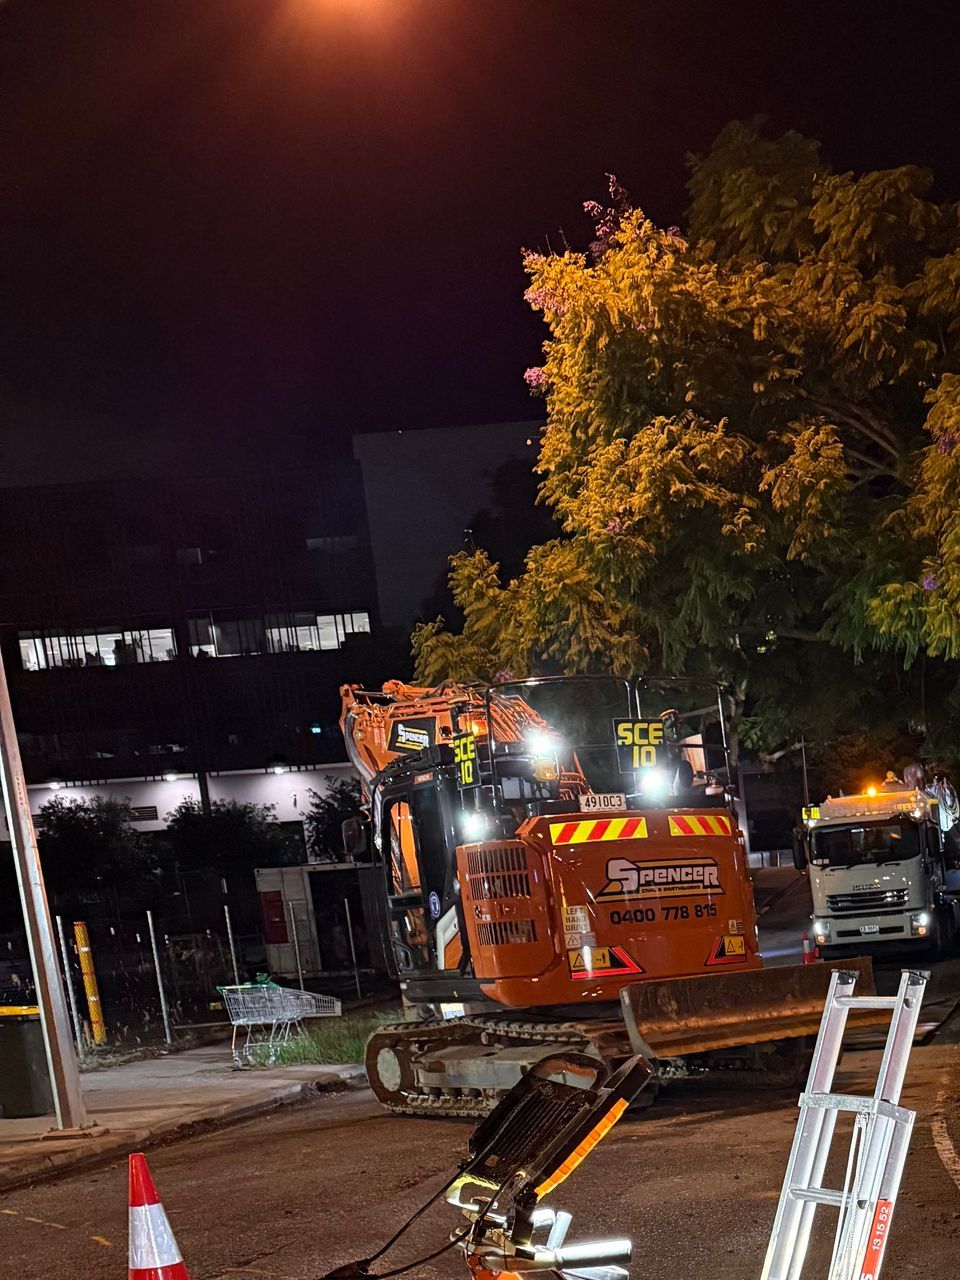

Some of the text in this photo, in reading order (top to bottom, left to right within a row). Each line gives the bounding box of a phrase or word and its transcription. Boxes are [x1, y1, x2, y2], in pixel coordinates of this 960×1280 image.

[617, 723, 664, 745] SCE
[454, 735, 475, 763] SCE
[632, 745, 656, 768] 10
[461, 761, 473, 785] 10
[606, 859, 720, 892] SPENCER
[609, 903, 717, 925] 0400 778 815
[872, 1238, 882, 1251] 13
[879, 1206, 889, 1221] 52
